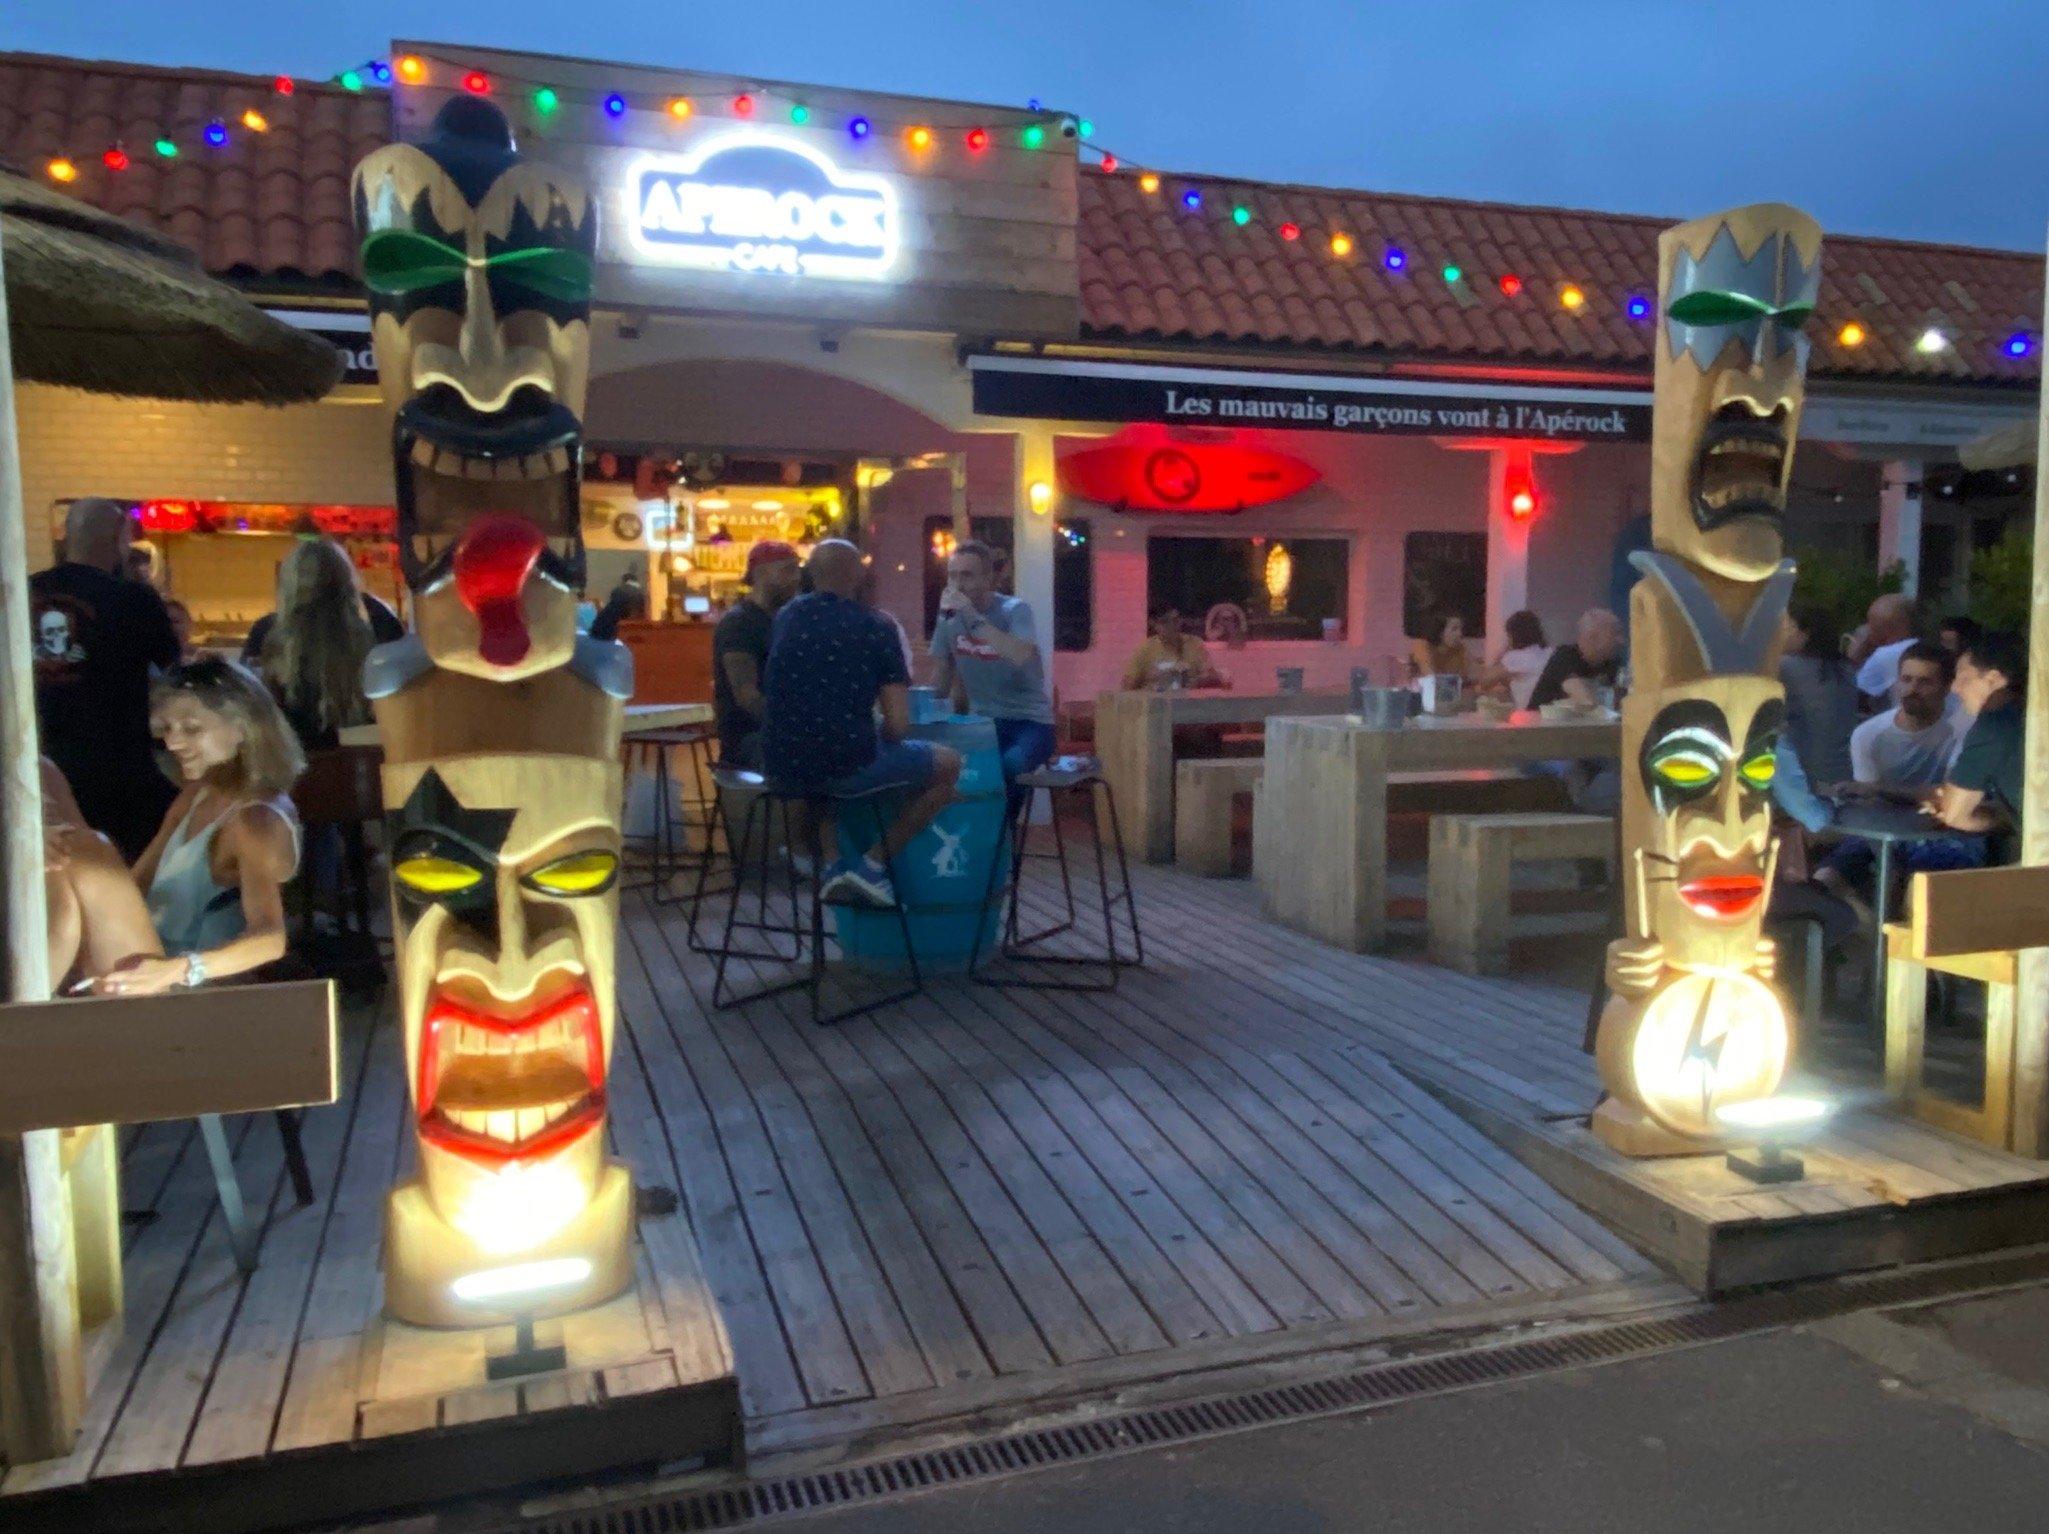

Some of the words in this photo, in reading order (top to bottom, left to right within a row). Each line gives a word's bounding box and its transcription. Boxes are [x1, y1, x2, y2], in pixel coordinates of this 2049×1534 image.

[1166, 390, 1212, 415] Les
[1218, 396, 1328, 420] mauvais
[1333, 404, 1432, 429] garçons
[1437, 408, 1490, 428] vont
[1496, 406, 1509, 429] à
[1516, 406, 1626, 436] l'Apérock
